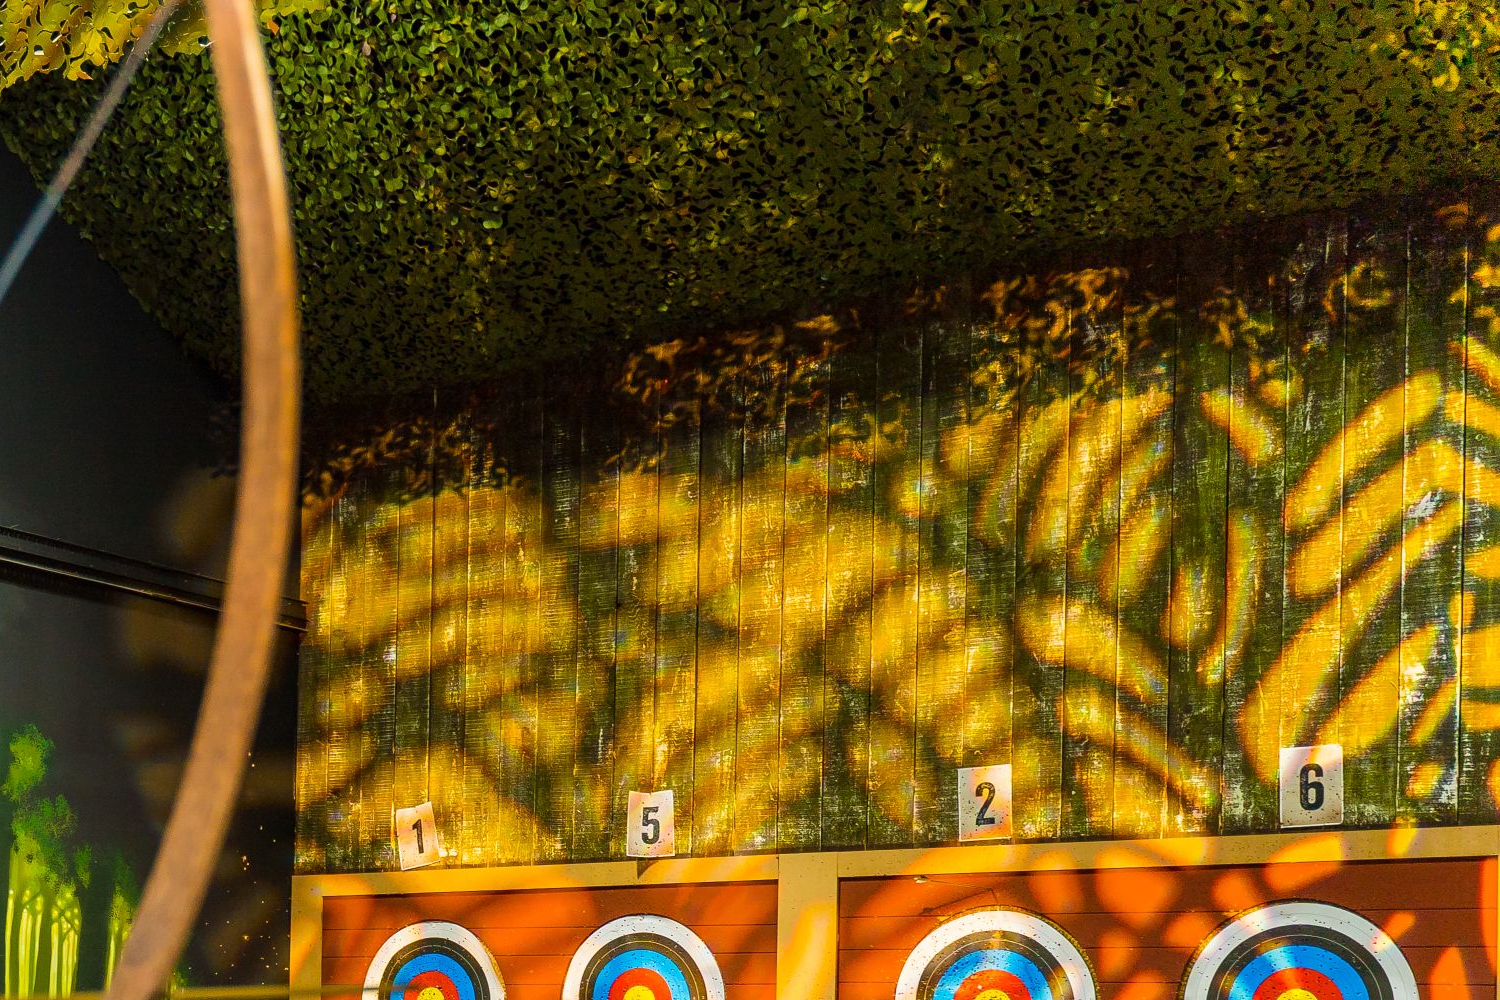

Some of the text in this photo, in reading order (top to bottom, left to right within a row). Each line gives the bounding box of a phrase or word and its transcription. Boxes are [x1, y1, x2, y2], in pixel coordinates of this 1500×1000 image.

[975, 781, 996, 826] 2
[1300, 763, 1324, 811] 6
[411, 818, 424, 854] 1
[641, 806, 660, 845] 5
